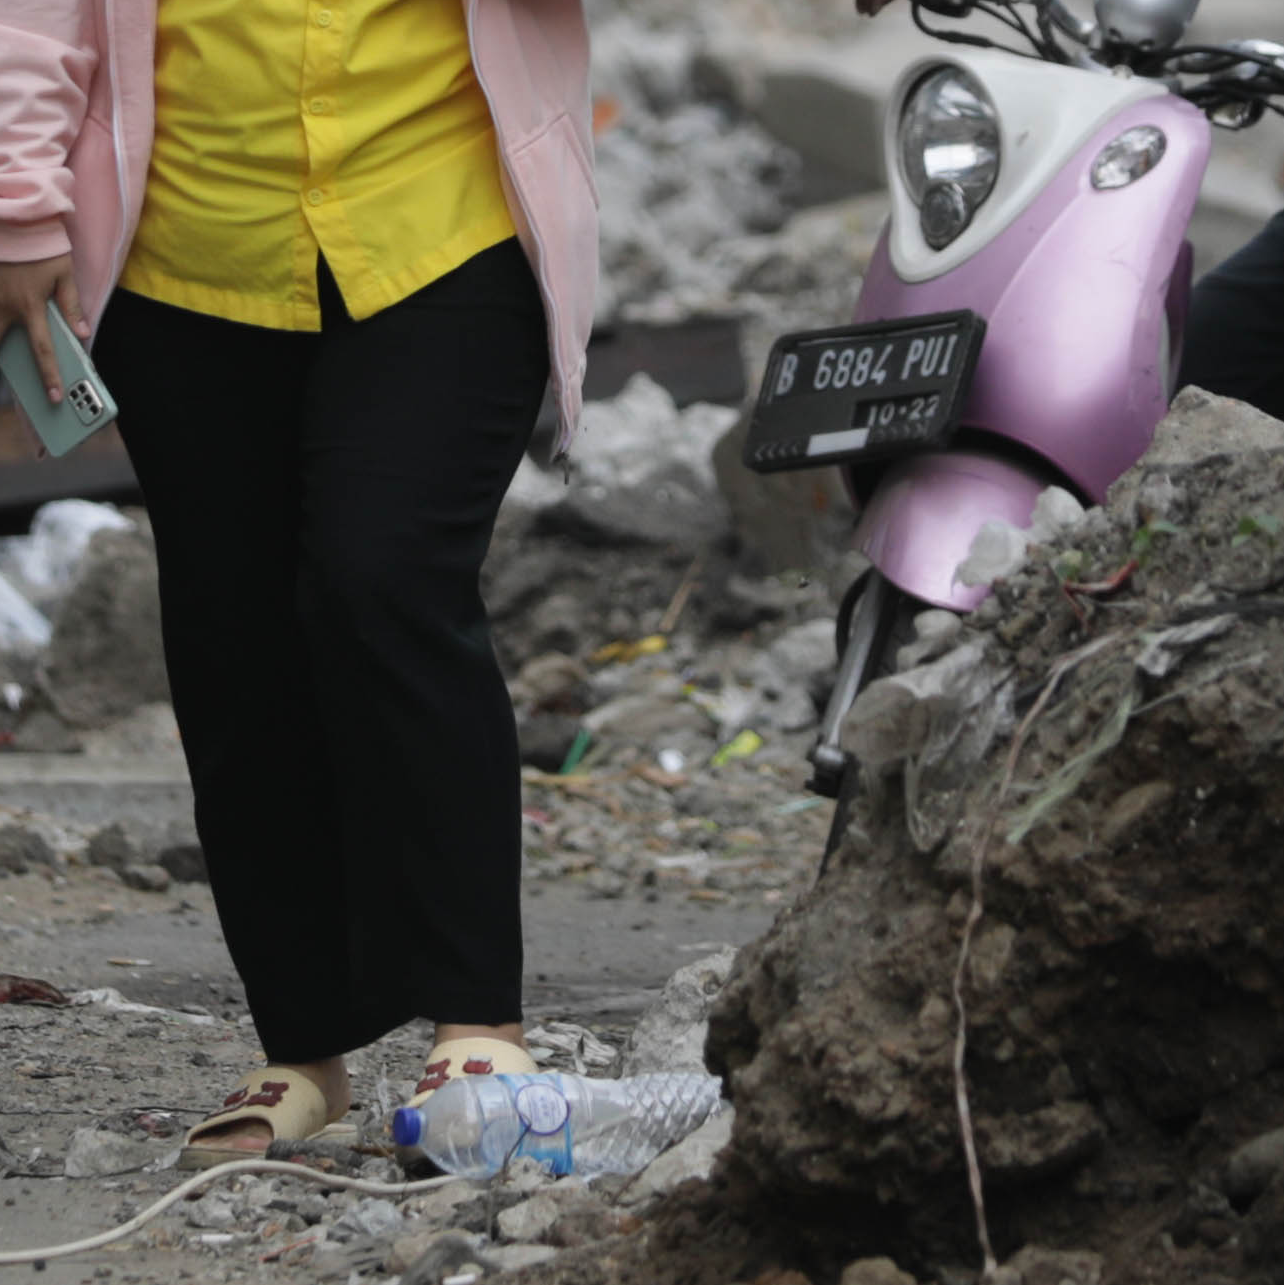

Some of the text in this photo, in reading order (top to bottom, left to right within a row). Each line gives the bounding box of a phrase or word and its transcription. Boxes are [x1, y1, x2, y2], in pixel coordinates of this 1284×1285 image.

[776, 333, 958, 396] B 6884 PUI
